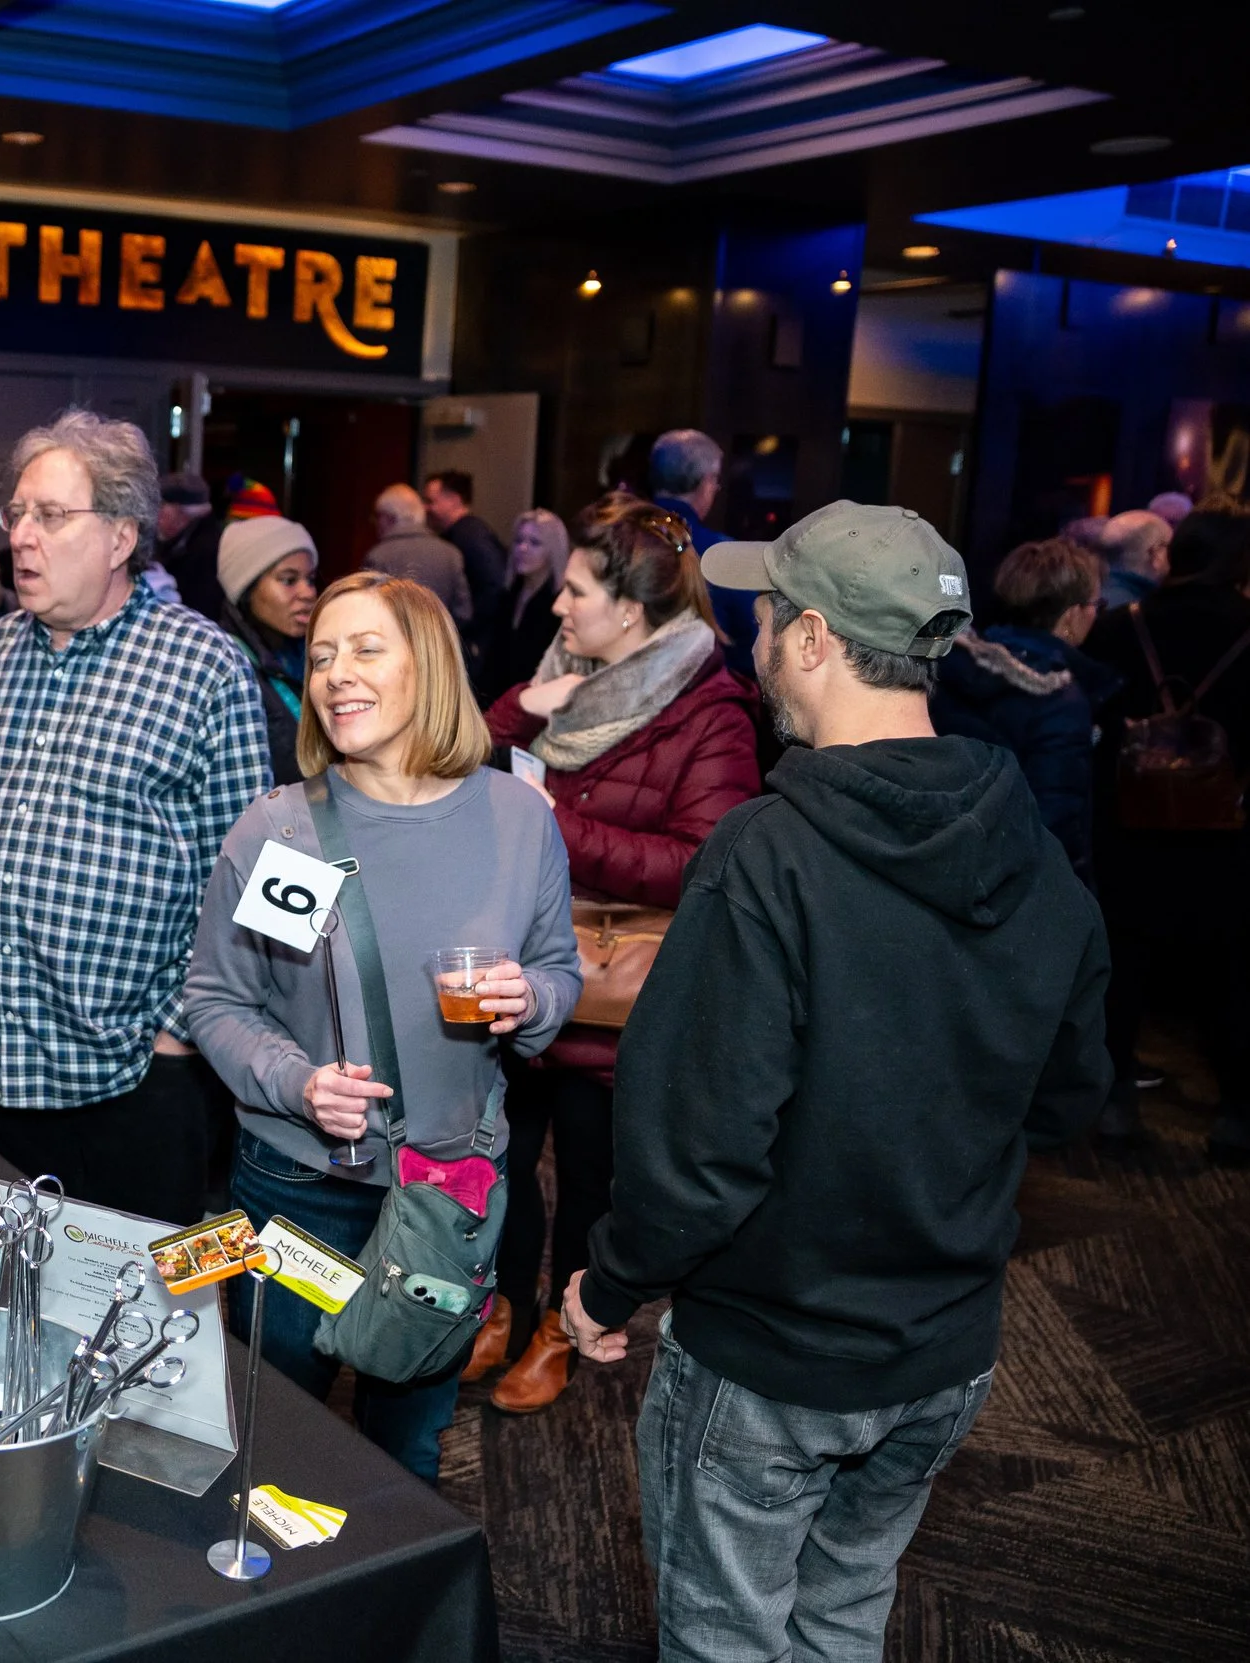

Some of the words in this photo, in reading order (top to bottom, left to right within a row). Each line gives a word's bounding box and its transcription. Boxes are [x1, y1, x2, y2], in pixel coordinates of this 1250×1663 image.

[262, 877, 317, 915] 6
[83, 1230, 129, 1250] MICHELE
[132, 1243, 141, 1252] C
[275, 1240, 342, 1285] MICHELE
[251, 1498, 299, 1536] MICHELE
